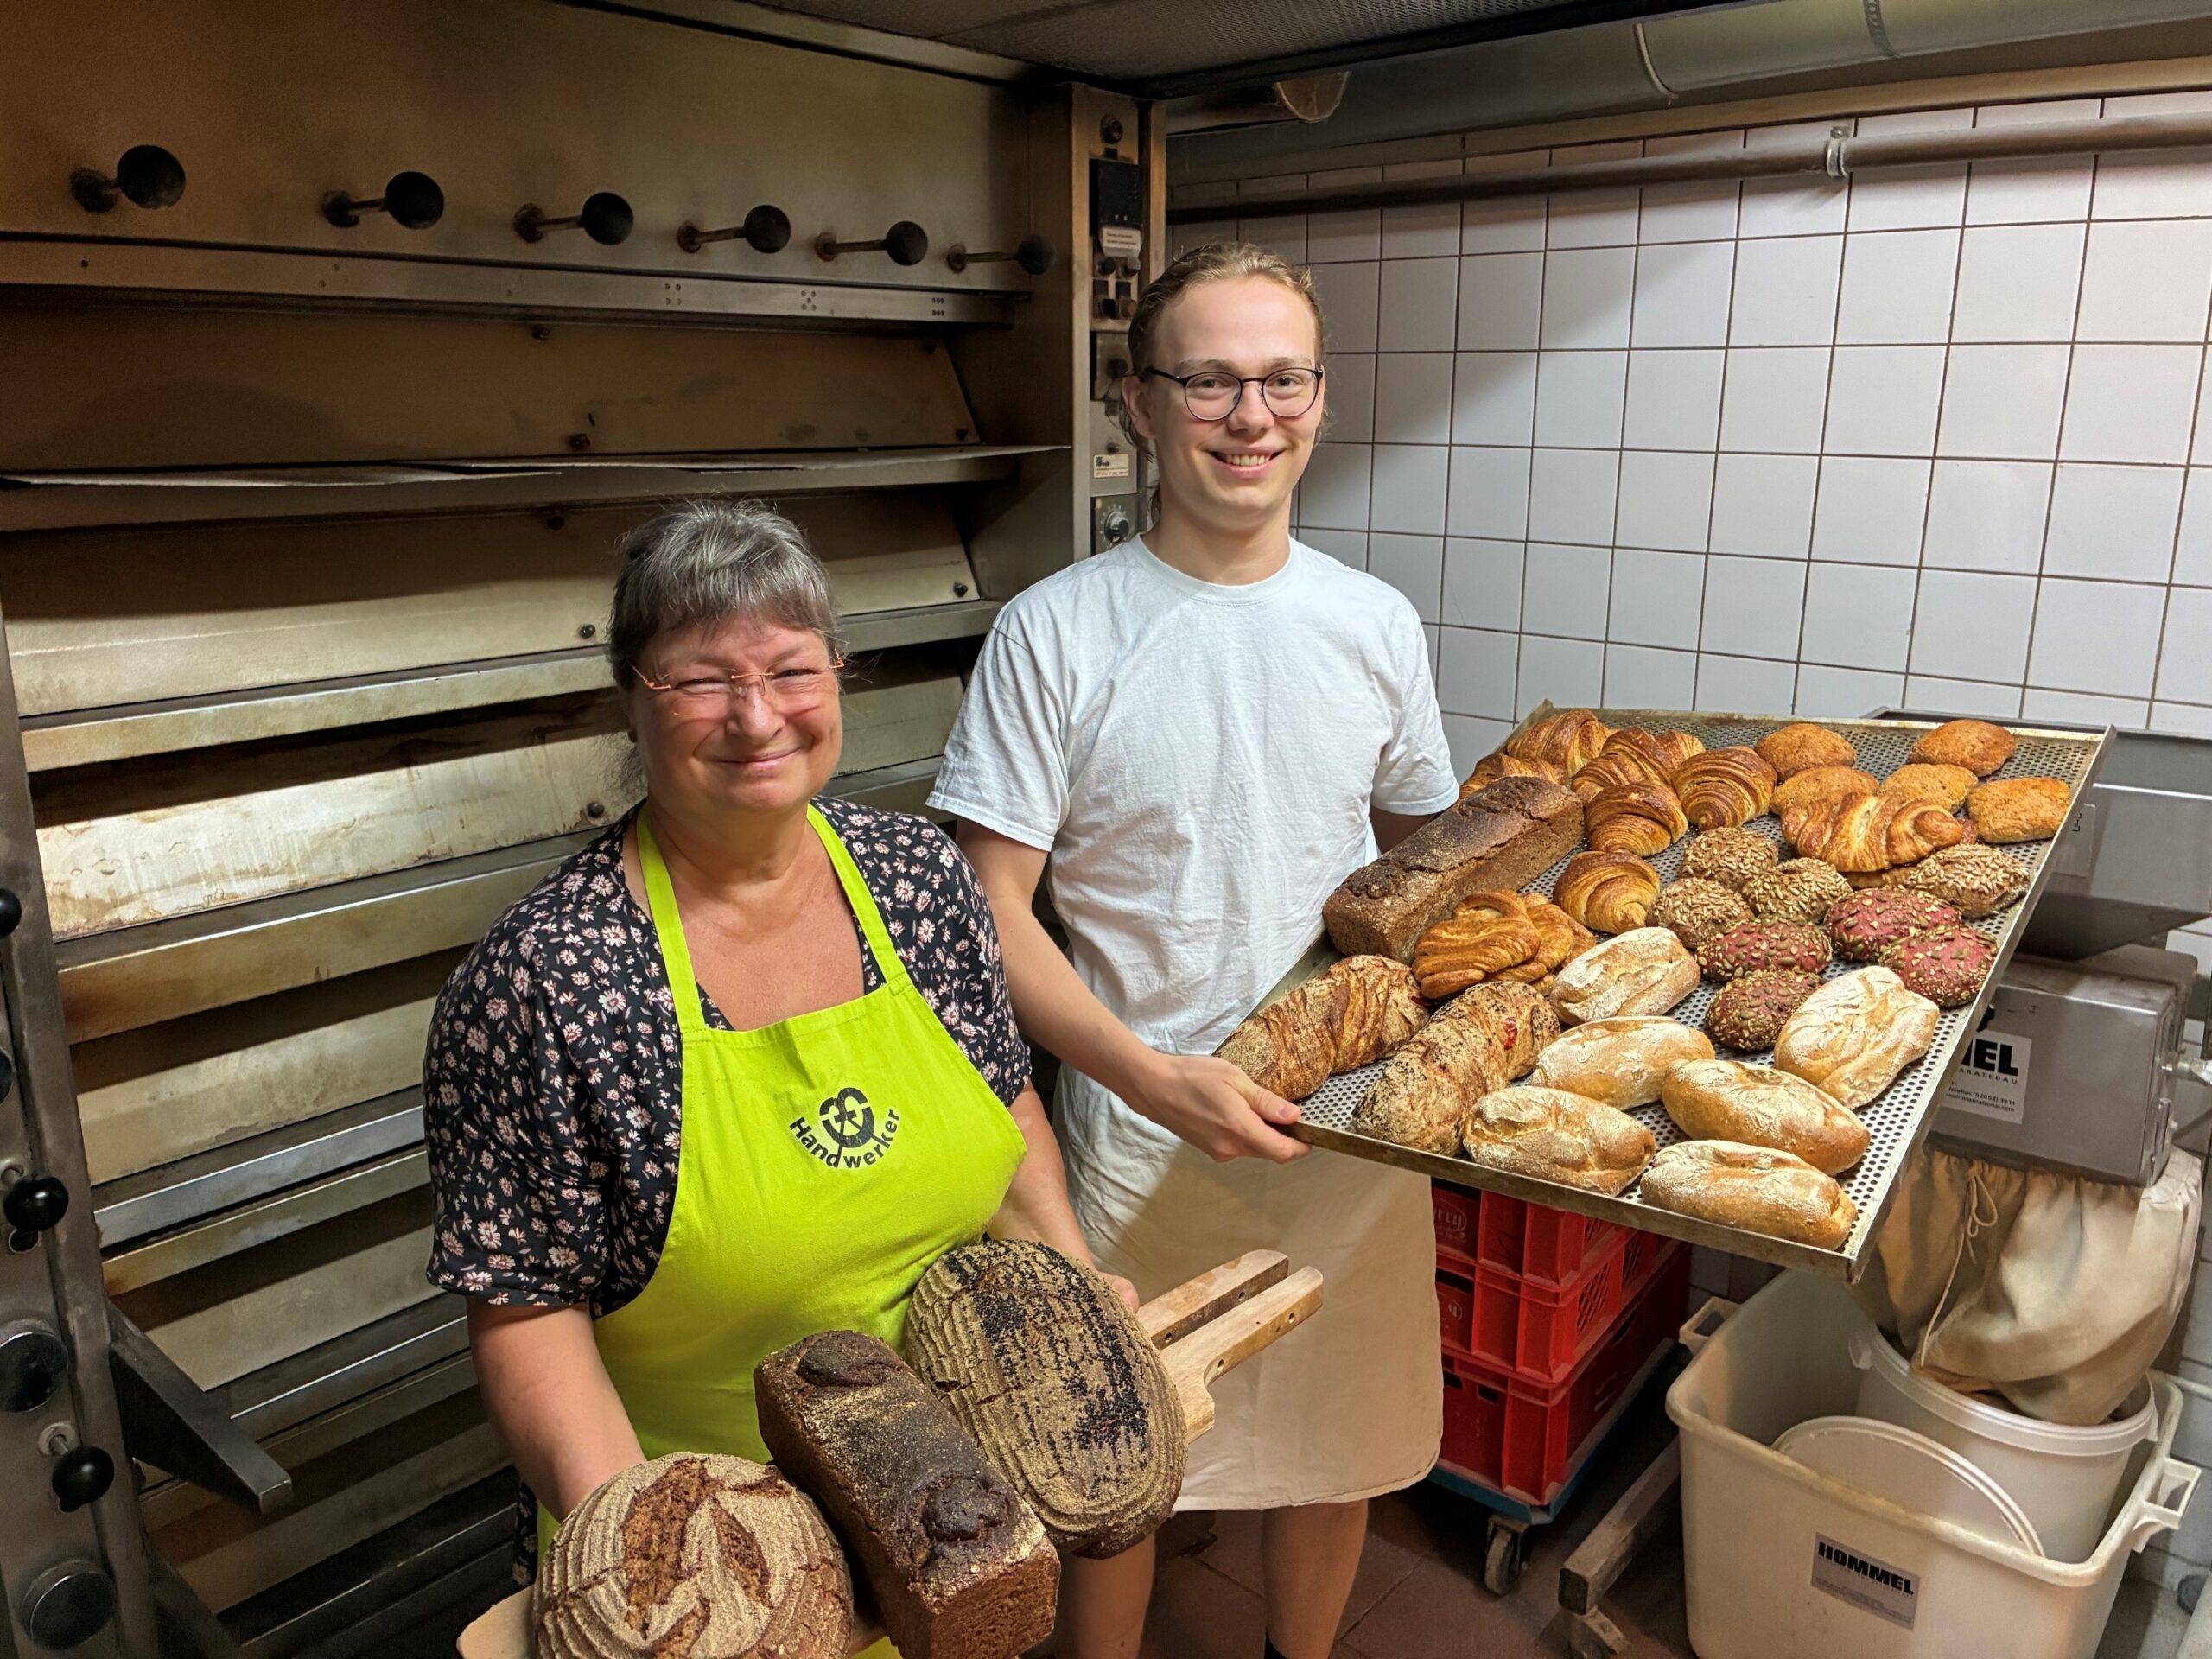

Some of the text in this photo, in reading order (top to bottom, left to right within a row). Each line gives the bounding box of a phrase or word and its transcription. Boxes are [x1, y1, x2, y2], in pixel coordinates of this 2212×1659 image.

[1961, 1038, 2018, 1077] EL
[789, 1109, 900, 1169] Handwerker
[1818, 1541, 1914, 1596] HOMMEL
